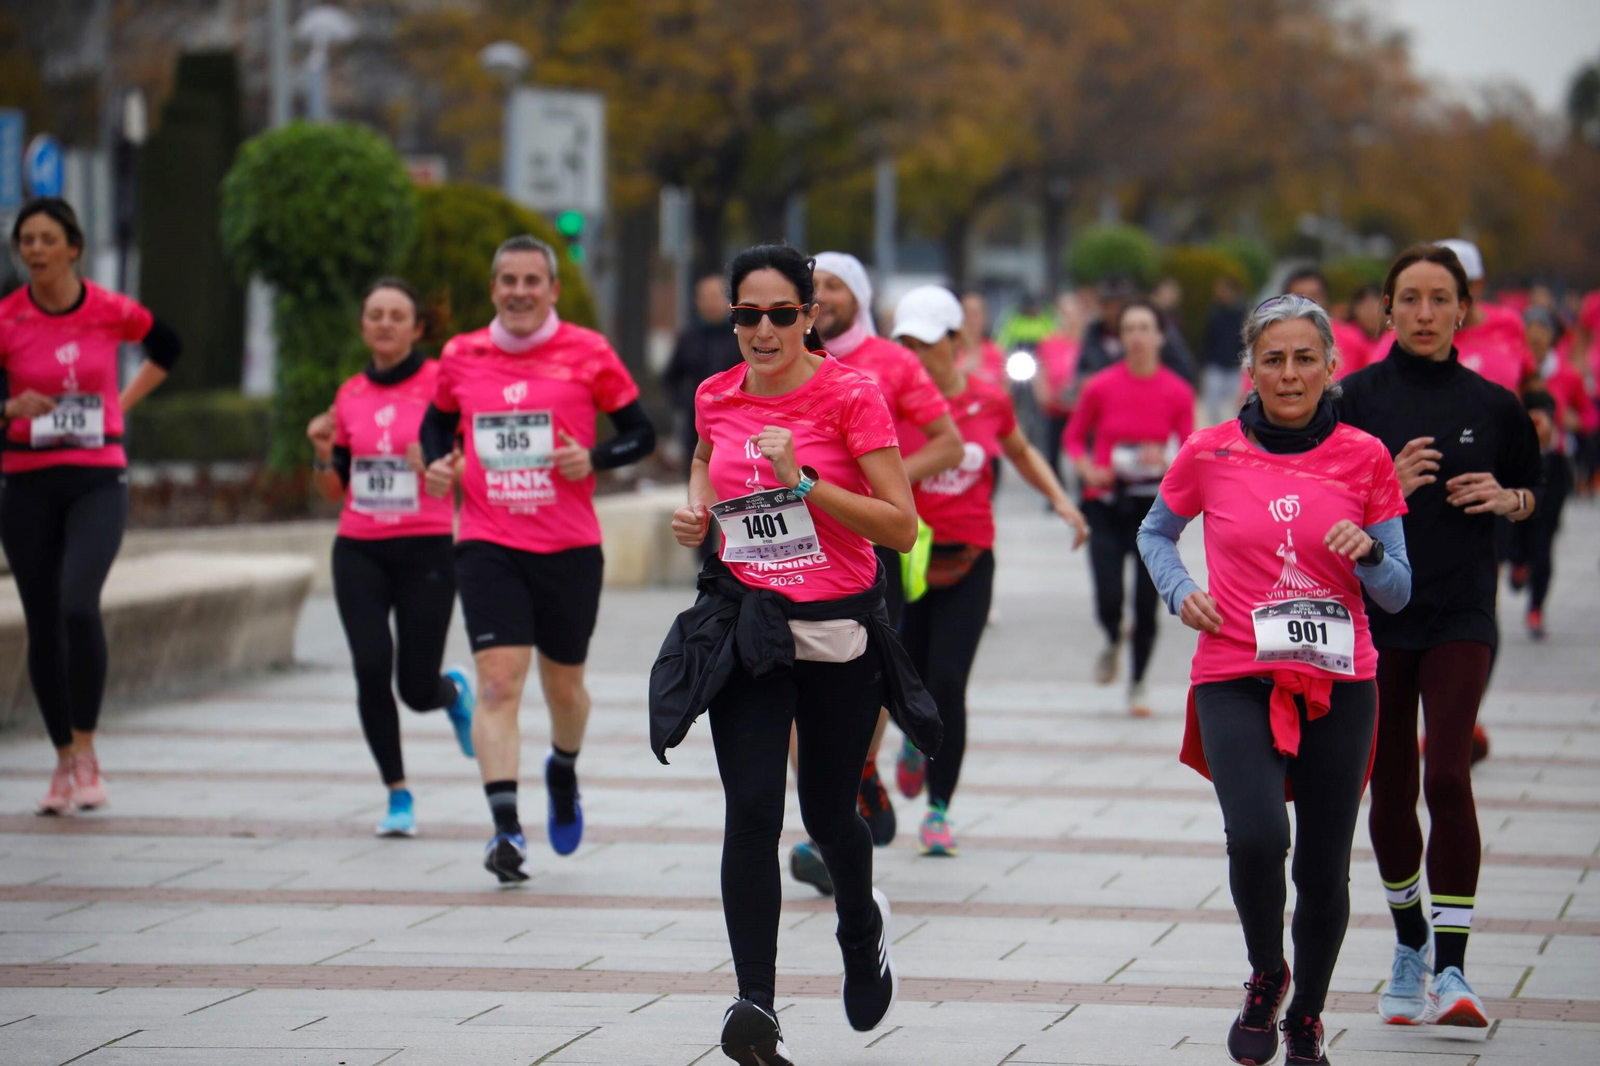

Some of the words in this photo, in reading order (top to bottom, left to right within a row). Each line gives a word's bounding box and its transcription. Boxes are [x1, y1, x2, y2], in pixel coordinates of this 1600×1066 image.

[496, 432, 530, 451] 365
[742, 512, 789, 539] 1401
[769, 575, 804, 587] 2023
[1265, 590, 1284, 600] VIII
[1287, 620, 1328, 645] 901
